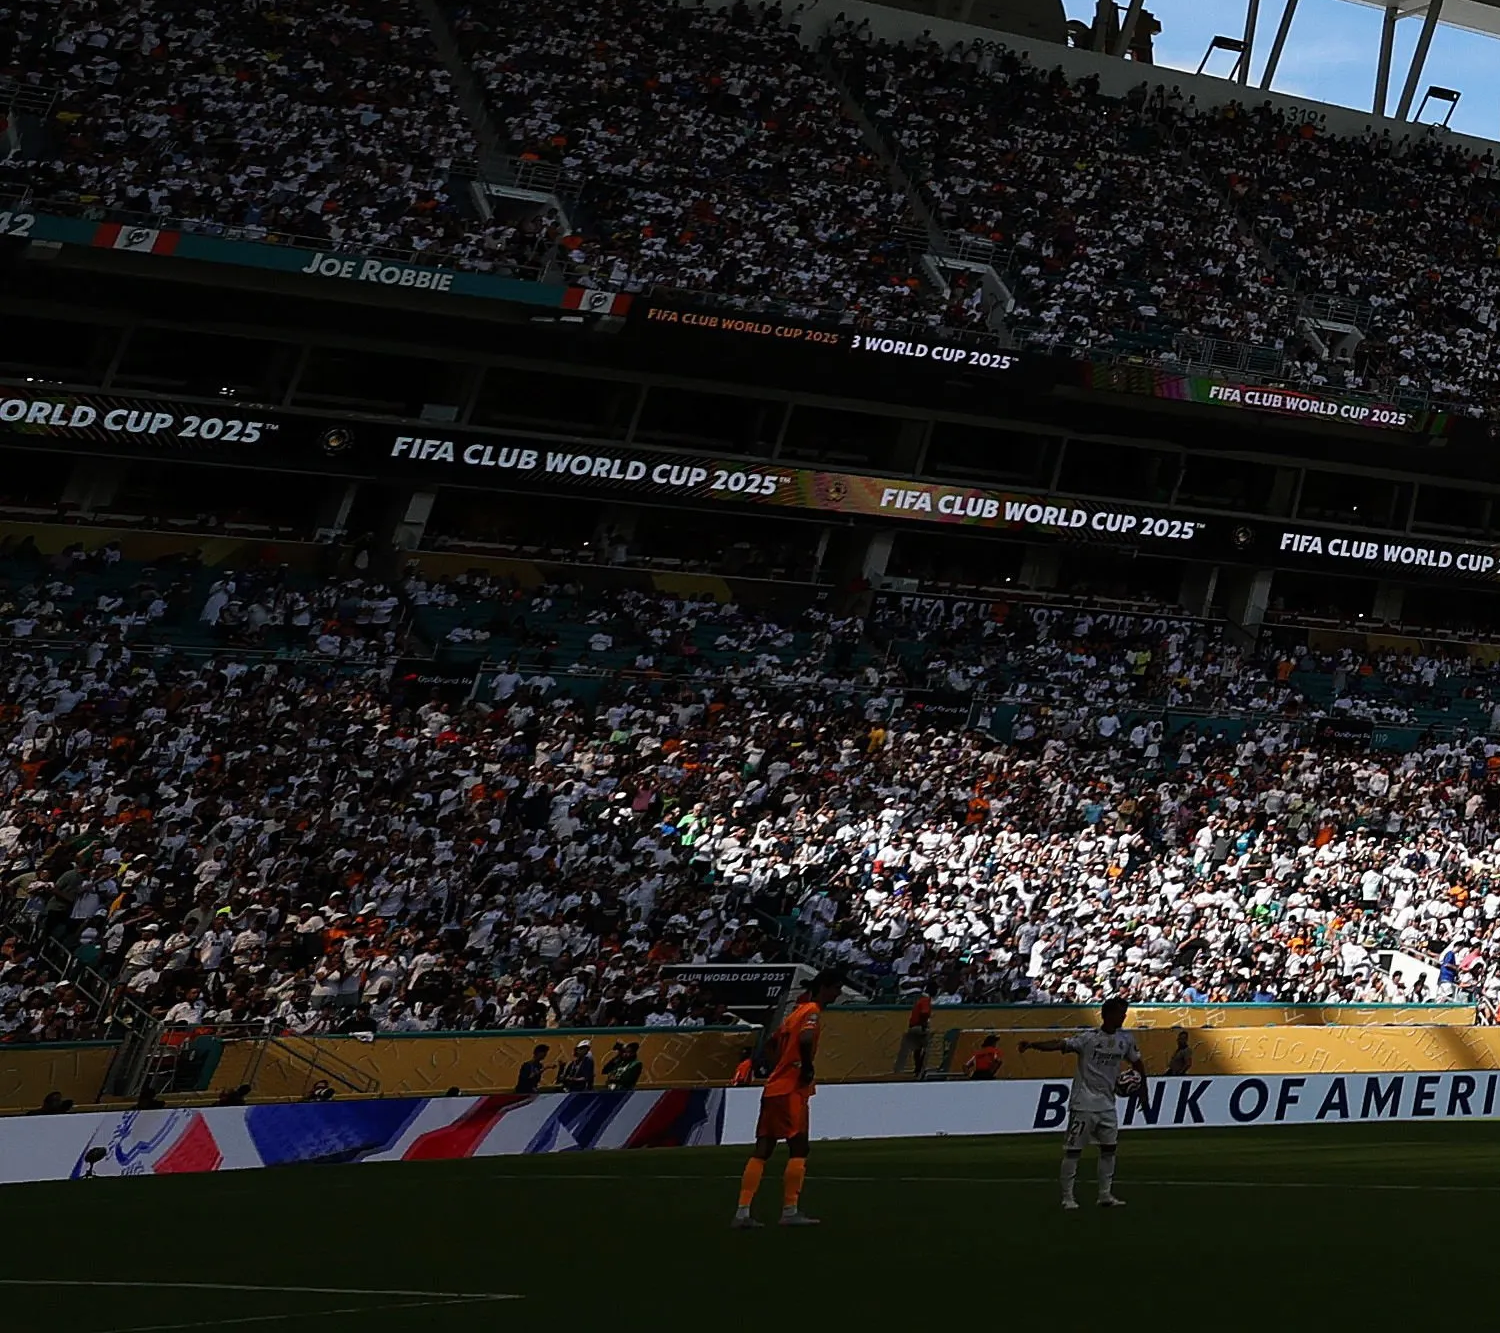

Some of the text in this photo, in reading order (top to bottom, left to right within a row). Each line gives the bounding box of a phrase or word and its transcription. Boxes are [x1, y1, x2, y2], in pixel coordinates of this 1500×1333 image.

[302, 252, 453, 290] JOE ROBBIE
[866, 336, 928, 356] WORLD
[932, 346, 965, 363] CUP
[0, 398, 96, 426] ORLD
[104, 408, 173, 433] CUP
[1209, 386, 1240, 402] FIFA
[1245, 391, 1282, 407] CLUB
[1286, 396, 1337, 414] WORLD
[1341, 405, 1368, 421] CUP
[392, 436, 453, 461] FIFA
[464, 444, 537, 469] CLUB
[546, 452, 646, 480] WORLD
[652, 463, 707, 486] CUP
[880, 488, 931, 511] FIFA
[938, 495, 999, 517] CLUB
[1005, 501, 1087, 527] WORLD
[1092, 511, 1136, 532] CUP
[1280, 532, 1322, 553] FIFA
[1328, 538, 1378, 559] CLUB
[1384, 544, 1452, 567] WORLD
[1457, 553, 1493, 572] CUP
[1033, 1080, 1212, 1129] BNK
[1229, 1078, 1306, 1123] OF
